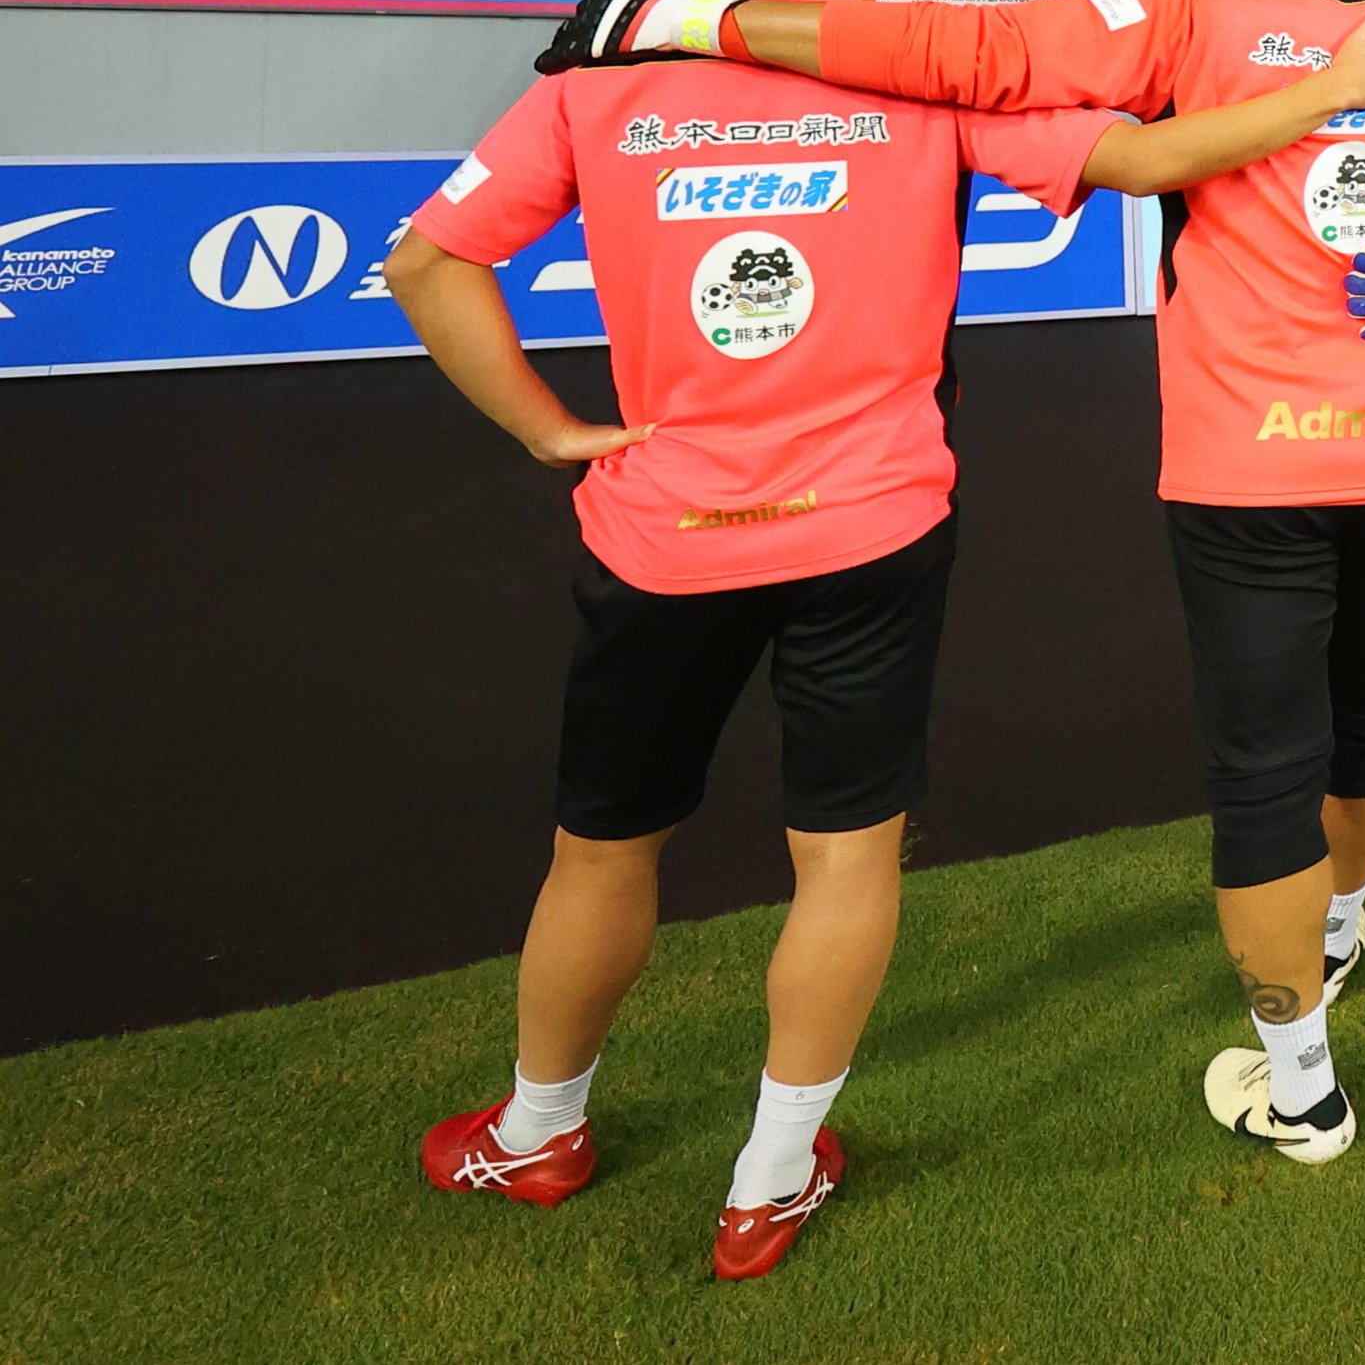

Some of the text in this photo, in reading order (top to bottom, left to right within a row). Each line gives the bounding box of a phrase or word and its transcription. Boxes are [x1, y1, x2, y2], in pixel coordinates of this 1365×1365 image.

[620, 114, 890, 152] 熊本日日新聞
[664, 169, 838, 214] いそざきの家
[0, 260, 107, 277] ALLIANCE
[0, 275, 76, 292] GROUP
[734, 323, 796, 343] 熊本市
[677, 489, 817, 532] Admiral
